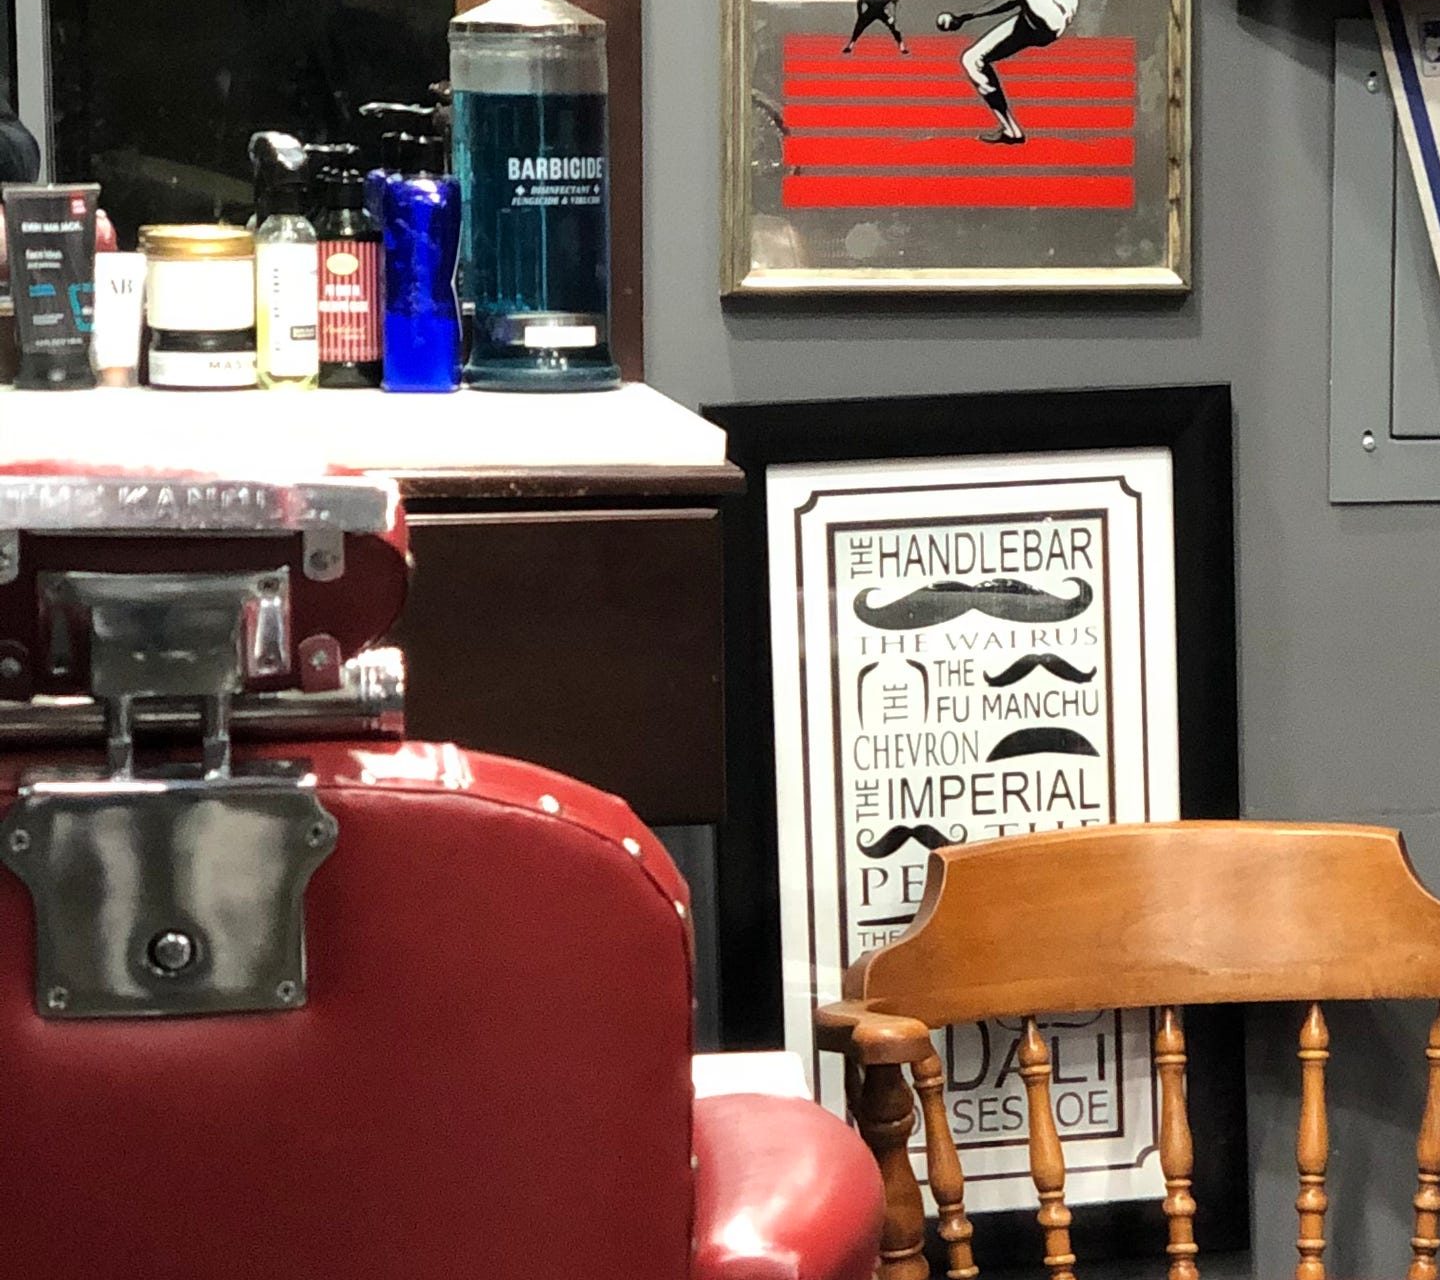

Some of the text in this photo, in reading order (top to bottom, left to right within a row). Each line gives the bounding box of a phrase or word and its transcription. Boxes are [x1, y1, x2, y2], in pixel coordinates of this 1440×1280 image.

[508, 157, 604, 180] BARBICIDE
[850, 527, 1093, 579] THE HANDLEBAR
[858, 633, 928, 656] THE
[933, 658, 975, 687] THE
[883, 683, 908, 724] THE
[937, 689, 1099, 723] FU MANCHU
[853, 730, 979, 771] CHEVRON
[856, 768, 1100, 823] THE IMPERIAL
